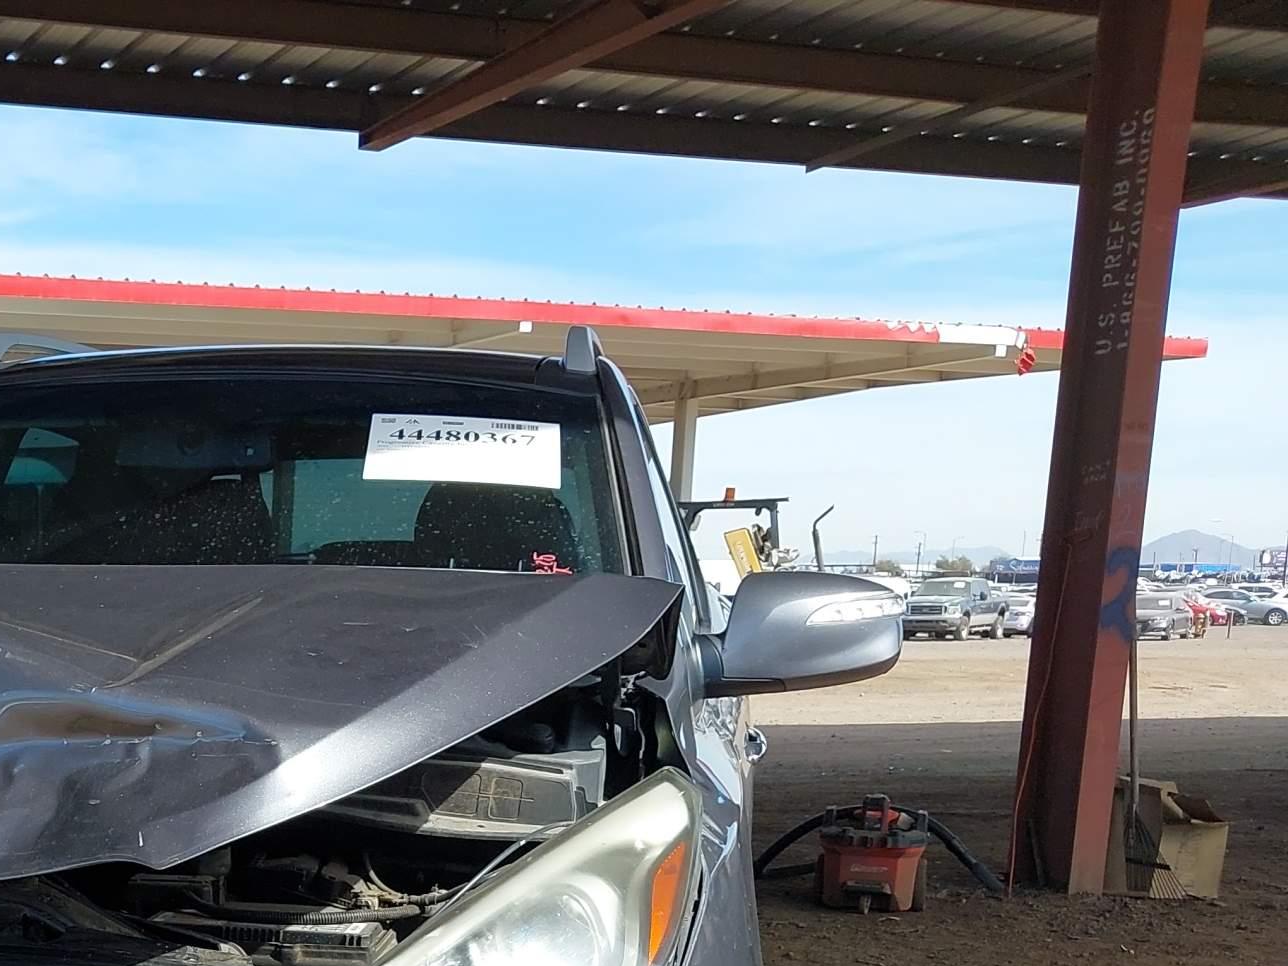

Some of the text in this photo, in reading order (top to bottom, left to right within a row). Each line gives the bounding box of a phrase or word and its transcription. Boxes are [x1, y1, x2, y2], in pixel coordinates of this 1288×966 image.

[1095, 110, 1141, 355] U.S. PREFAB INC.
[389, 428, 536, 446] 44480367
